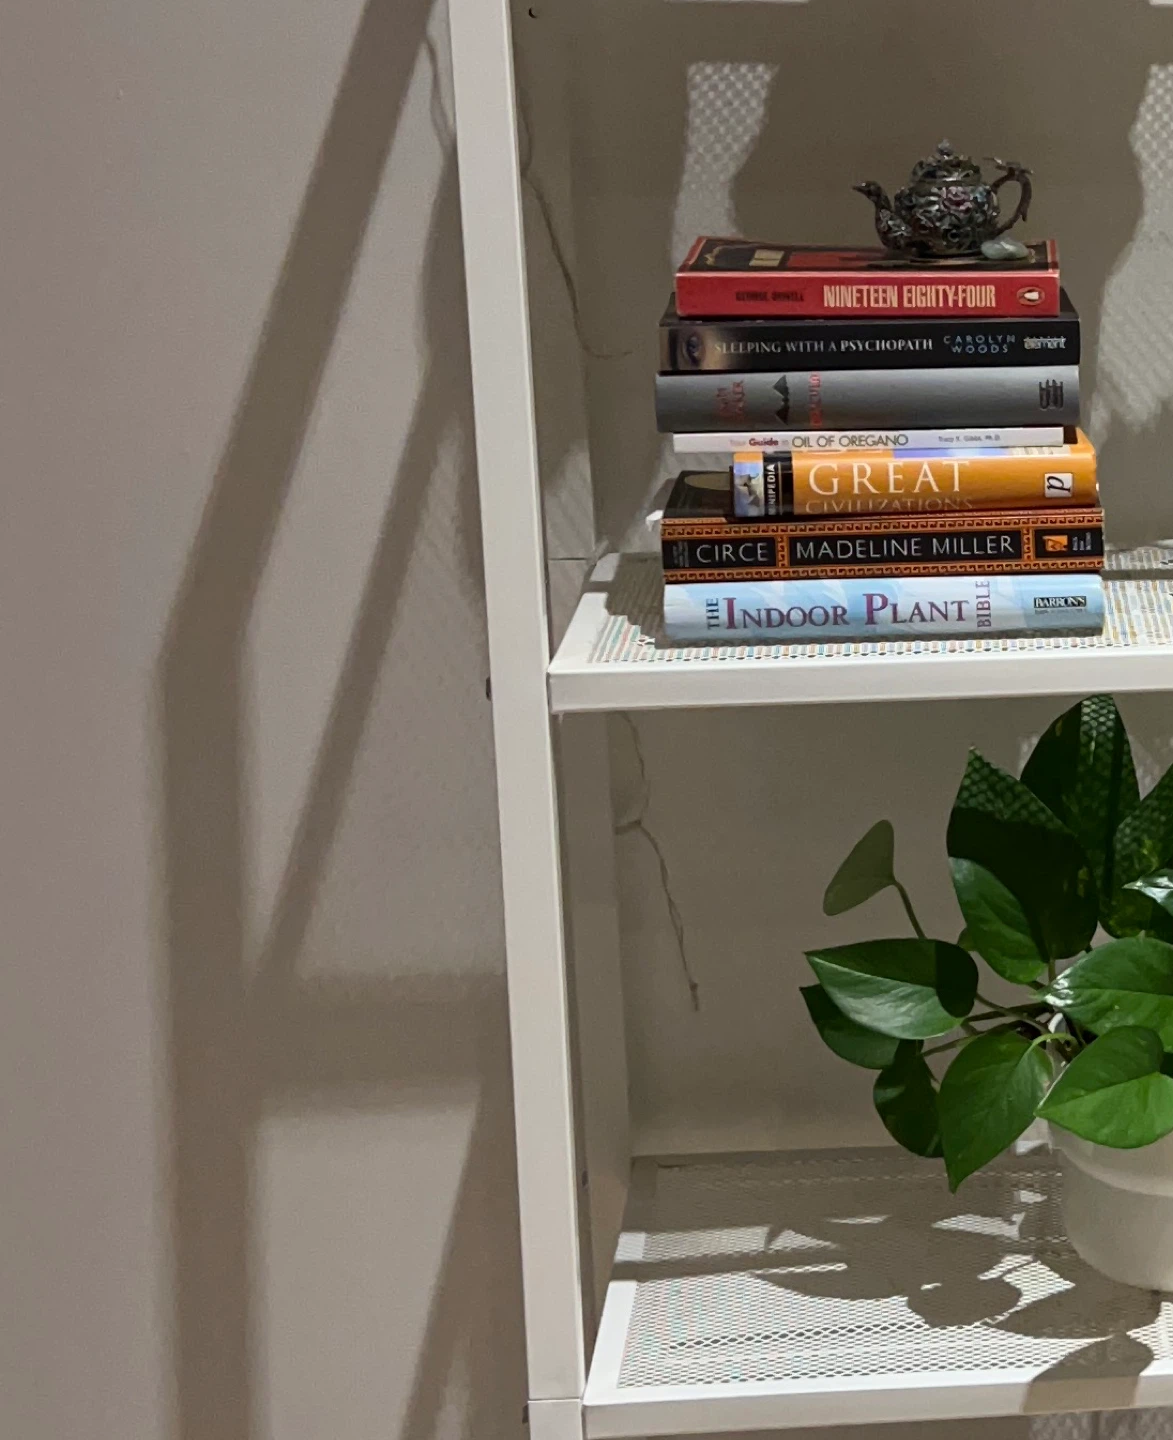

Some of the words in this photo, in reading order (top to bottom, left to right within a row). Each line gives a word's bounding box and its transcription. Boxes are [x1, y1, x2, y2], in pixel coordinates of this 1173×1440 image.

[823, 285, 898, 308] NINETEEN
[902, 284, 996, 308] EIGHTY-FOUR
[715, 341, 781, 355] SLEEPING
[785, 340, 825, 354] WITH
[827, 341, 838, 352] A
[839, 338, 933, 353] PSYCHOPATH
[943, 333, 1016, 345] CAROLYN
[951, 345, 1009, 355] WOODS
[749, 437, 778, 447] Guide
[791, 435, 813, 448] OIL
[816, 435, 835, 448] OF
[838, 433, 909, 447] OREGANO
[808, 460, 970, 496] GREAT
[805, 497, 974, 514] CIVILIZATIONS
[696, 542, 770, 563] CIRCE
[796, 537, 922, 559] MADELINE
[932, 534, 1015, 555] MILLER
[706, 597, 720, 630] THE
[722, 597, 851, 629] INDOOR
[862, 593, 970, 627] PLANT
[974, 580, 992, 628] BIBLE
